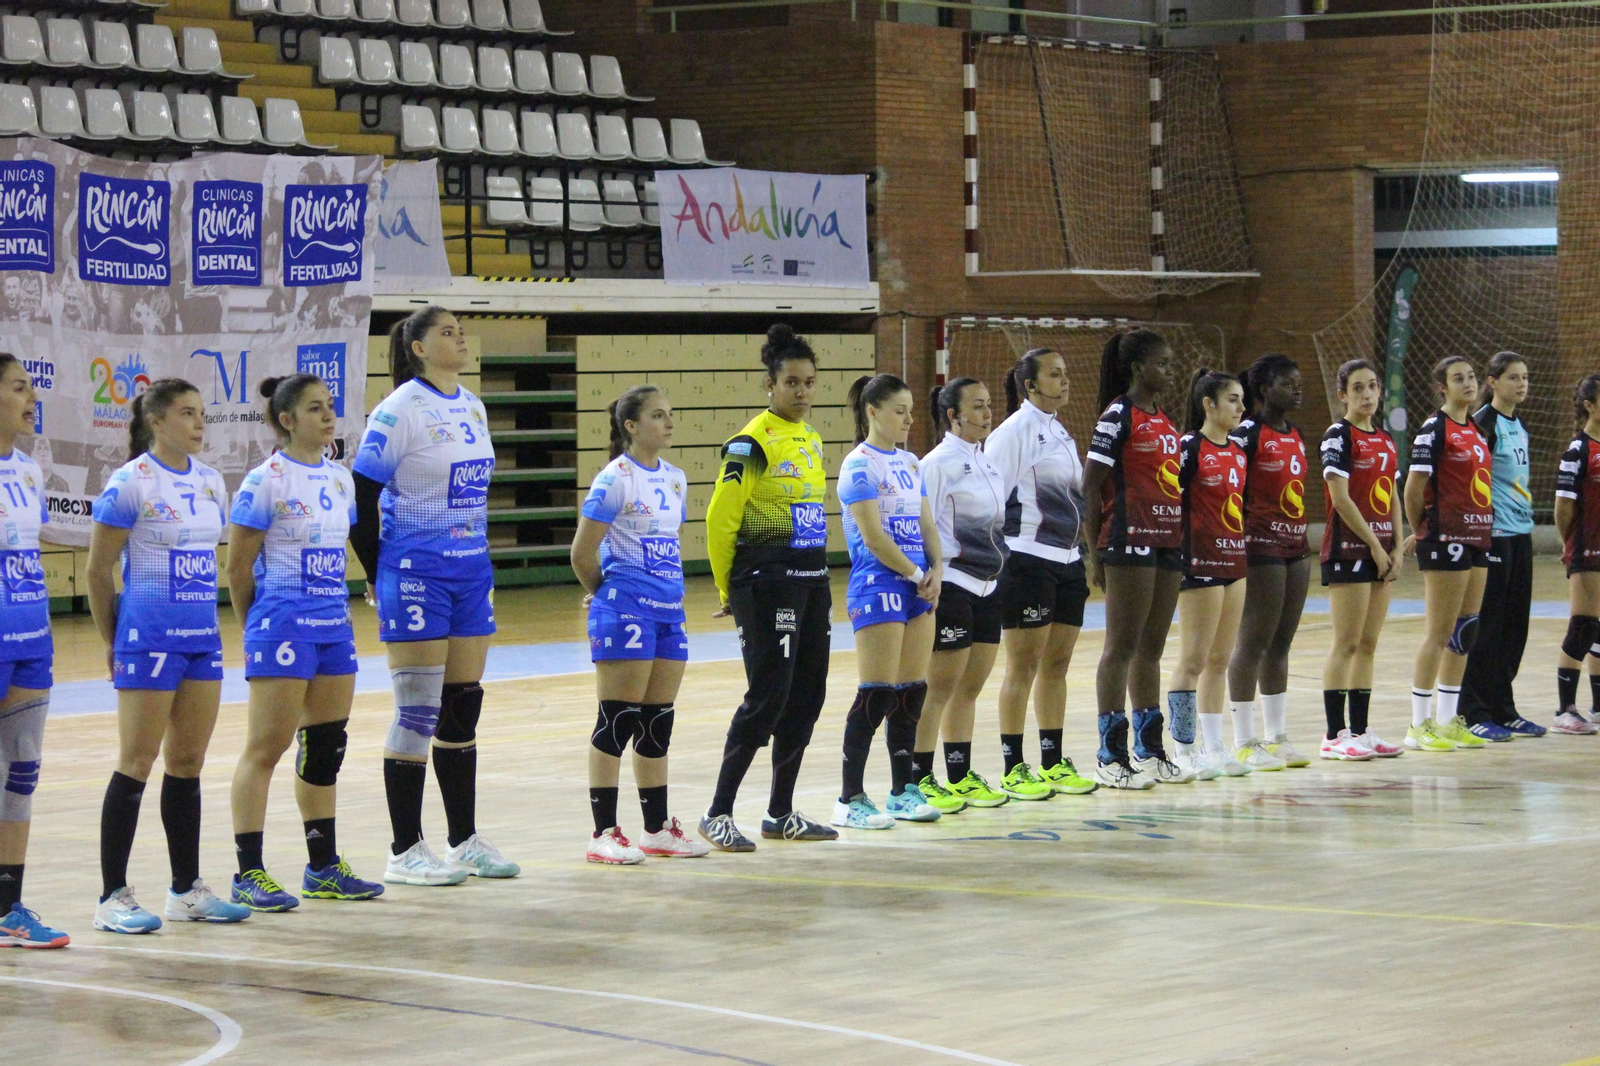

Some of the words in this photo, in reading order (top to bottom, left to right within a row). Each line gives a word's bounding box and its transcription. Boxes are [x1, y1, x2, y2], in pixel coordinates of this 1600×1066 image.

[0, 169, 44, 182] INICAS
[202, 188, 253, 202] CLINICAS
[671, 173, 852, 249] Andalucía
[87, 259, 167, 280] FERTILIDAD
[199, 254, 255, 271] DENTAL
[290, 261, 358, 281] FERTILIDAD
[301, 350, 320, 360] sabor
[230, 411, 239, 423] de
[460, 422, 476, 444] 3
[1159, 434, 1177, 455] 13
[1473, 444, 1485, 463] 9
[799, 447, 812, 469] 1
[1290, 455, 1301, 475] 6
[1378, 452, 1388, 471] 7
[1513, 448, 1527, 465] 12
[892, 469, 914, 490] 10
[1228, 468, 1239, 488] 4
[3, 482, 28, 507] 11
[180, 493, 196, 515] 7
[319, 487, 332, 510] 6
[654, 488, 670, 510] 2
[1447, 543, 1464, 562] 9
[878, 592, 902, 612] 10
[406, 605, 425, 631] 3
[625, 624, 642, 648] 2
[779, 634, 790, 658] 1
[276, 641, 295, 666] 6
[149, 652, 167, 677] 7
